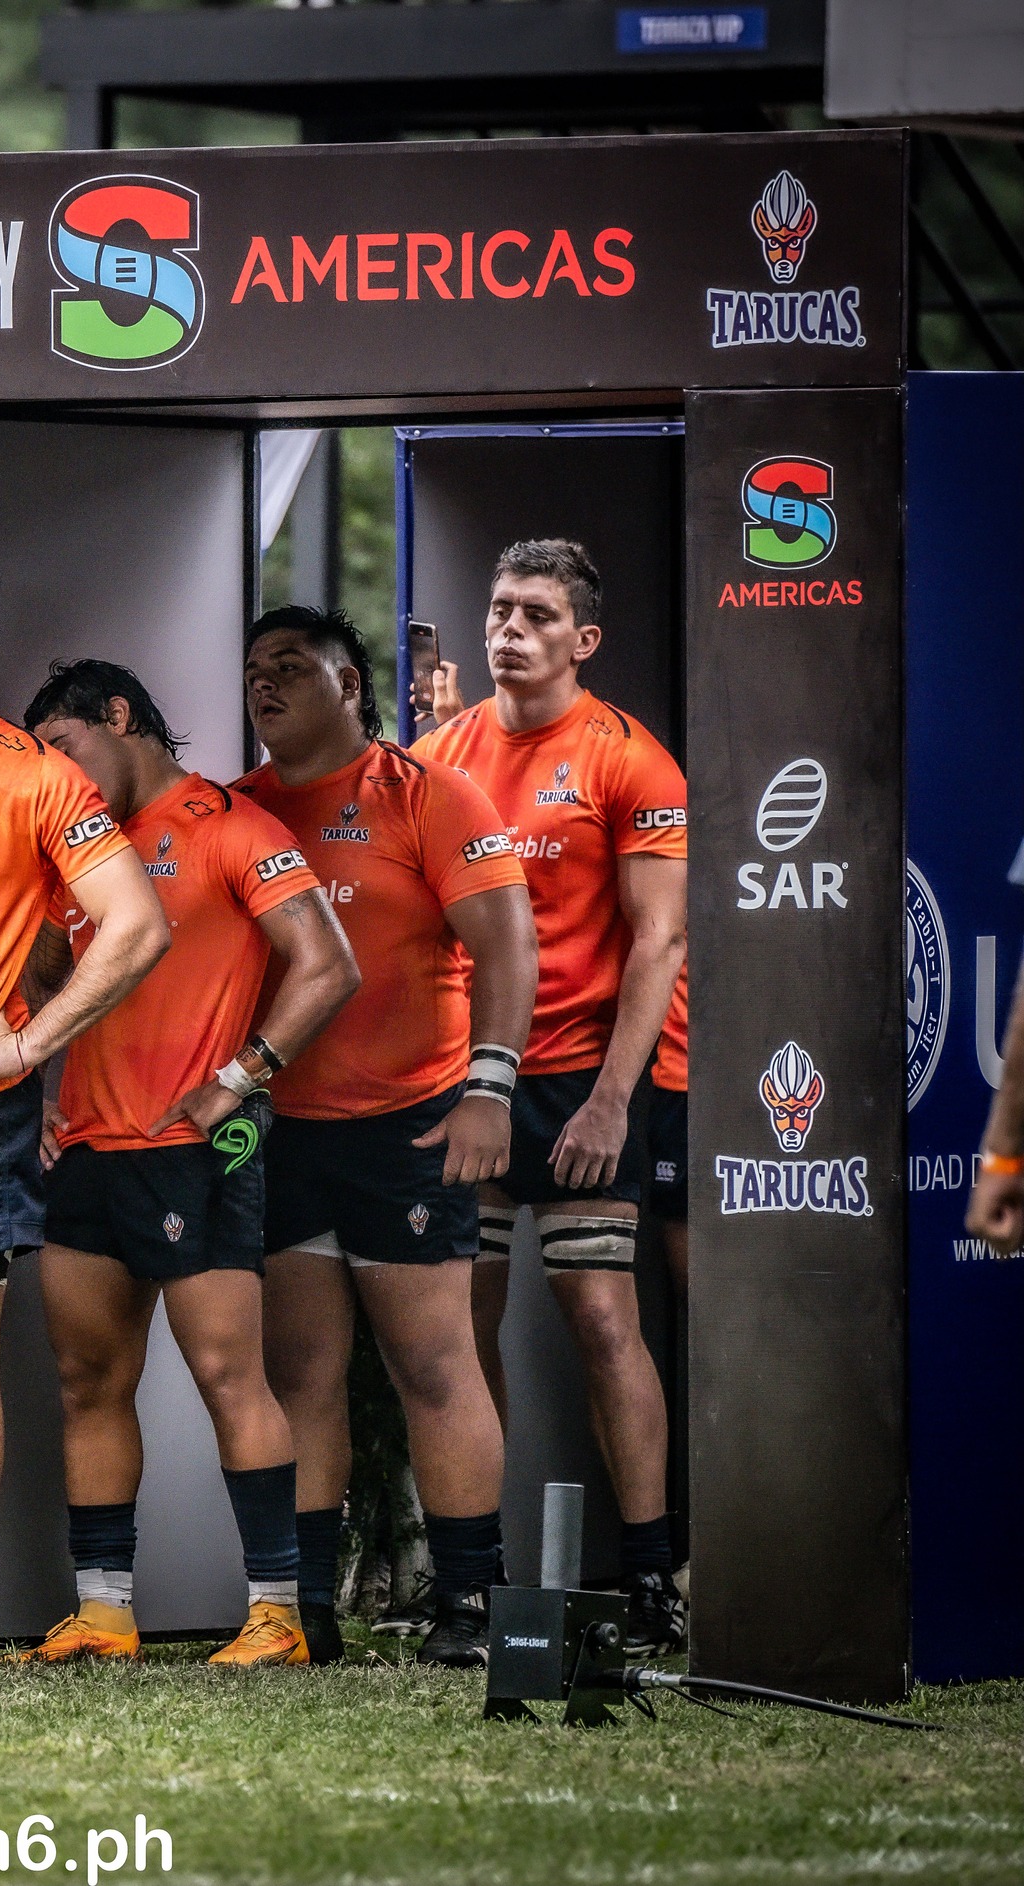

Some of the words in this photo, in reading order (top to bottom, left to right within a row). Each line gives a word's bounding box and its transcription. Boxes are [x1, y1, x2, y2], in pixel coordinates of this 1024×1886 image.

[230, 227, 636, 304] AMERICAS
[706, 286, 861, 348] TARUCAS
[719, 580, 863, 608] AMERICAS
[537, 789, 577, 804] TARUCAS
[636, 808, 687, 829] JCB
[321, 827, 369, 842] TARUCAS
[466, 835, 512, 860] JCB
[260, 850, 307, 880] JCB
[736, 862, 849, 910] SAR
[716, 1155, 868, 1216] TARUCAS
[908, 1154, 963, 1191] IDAD
